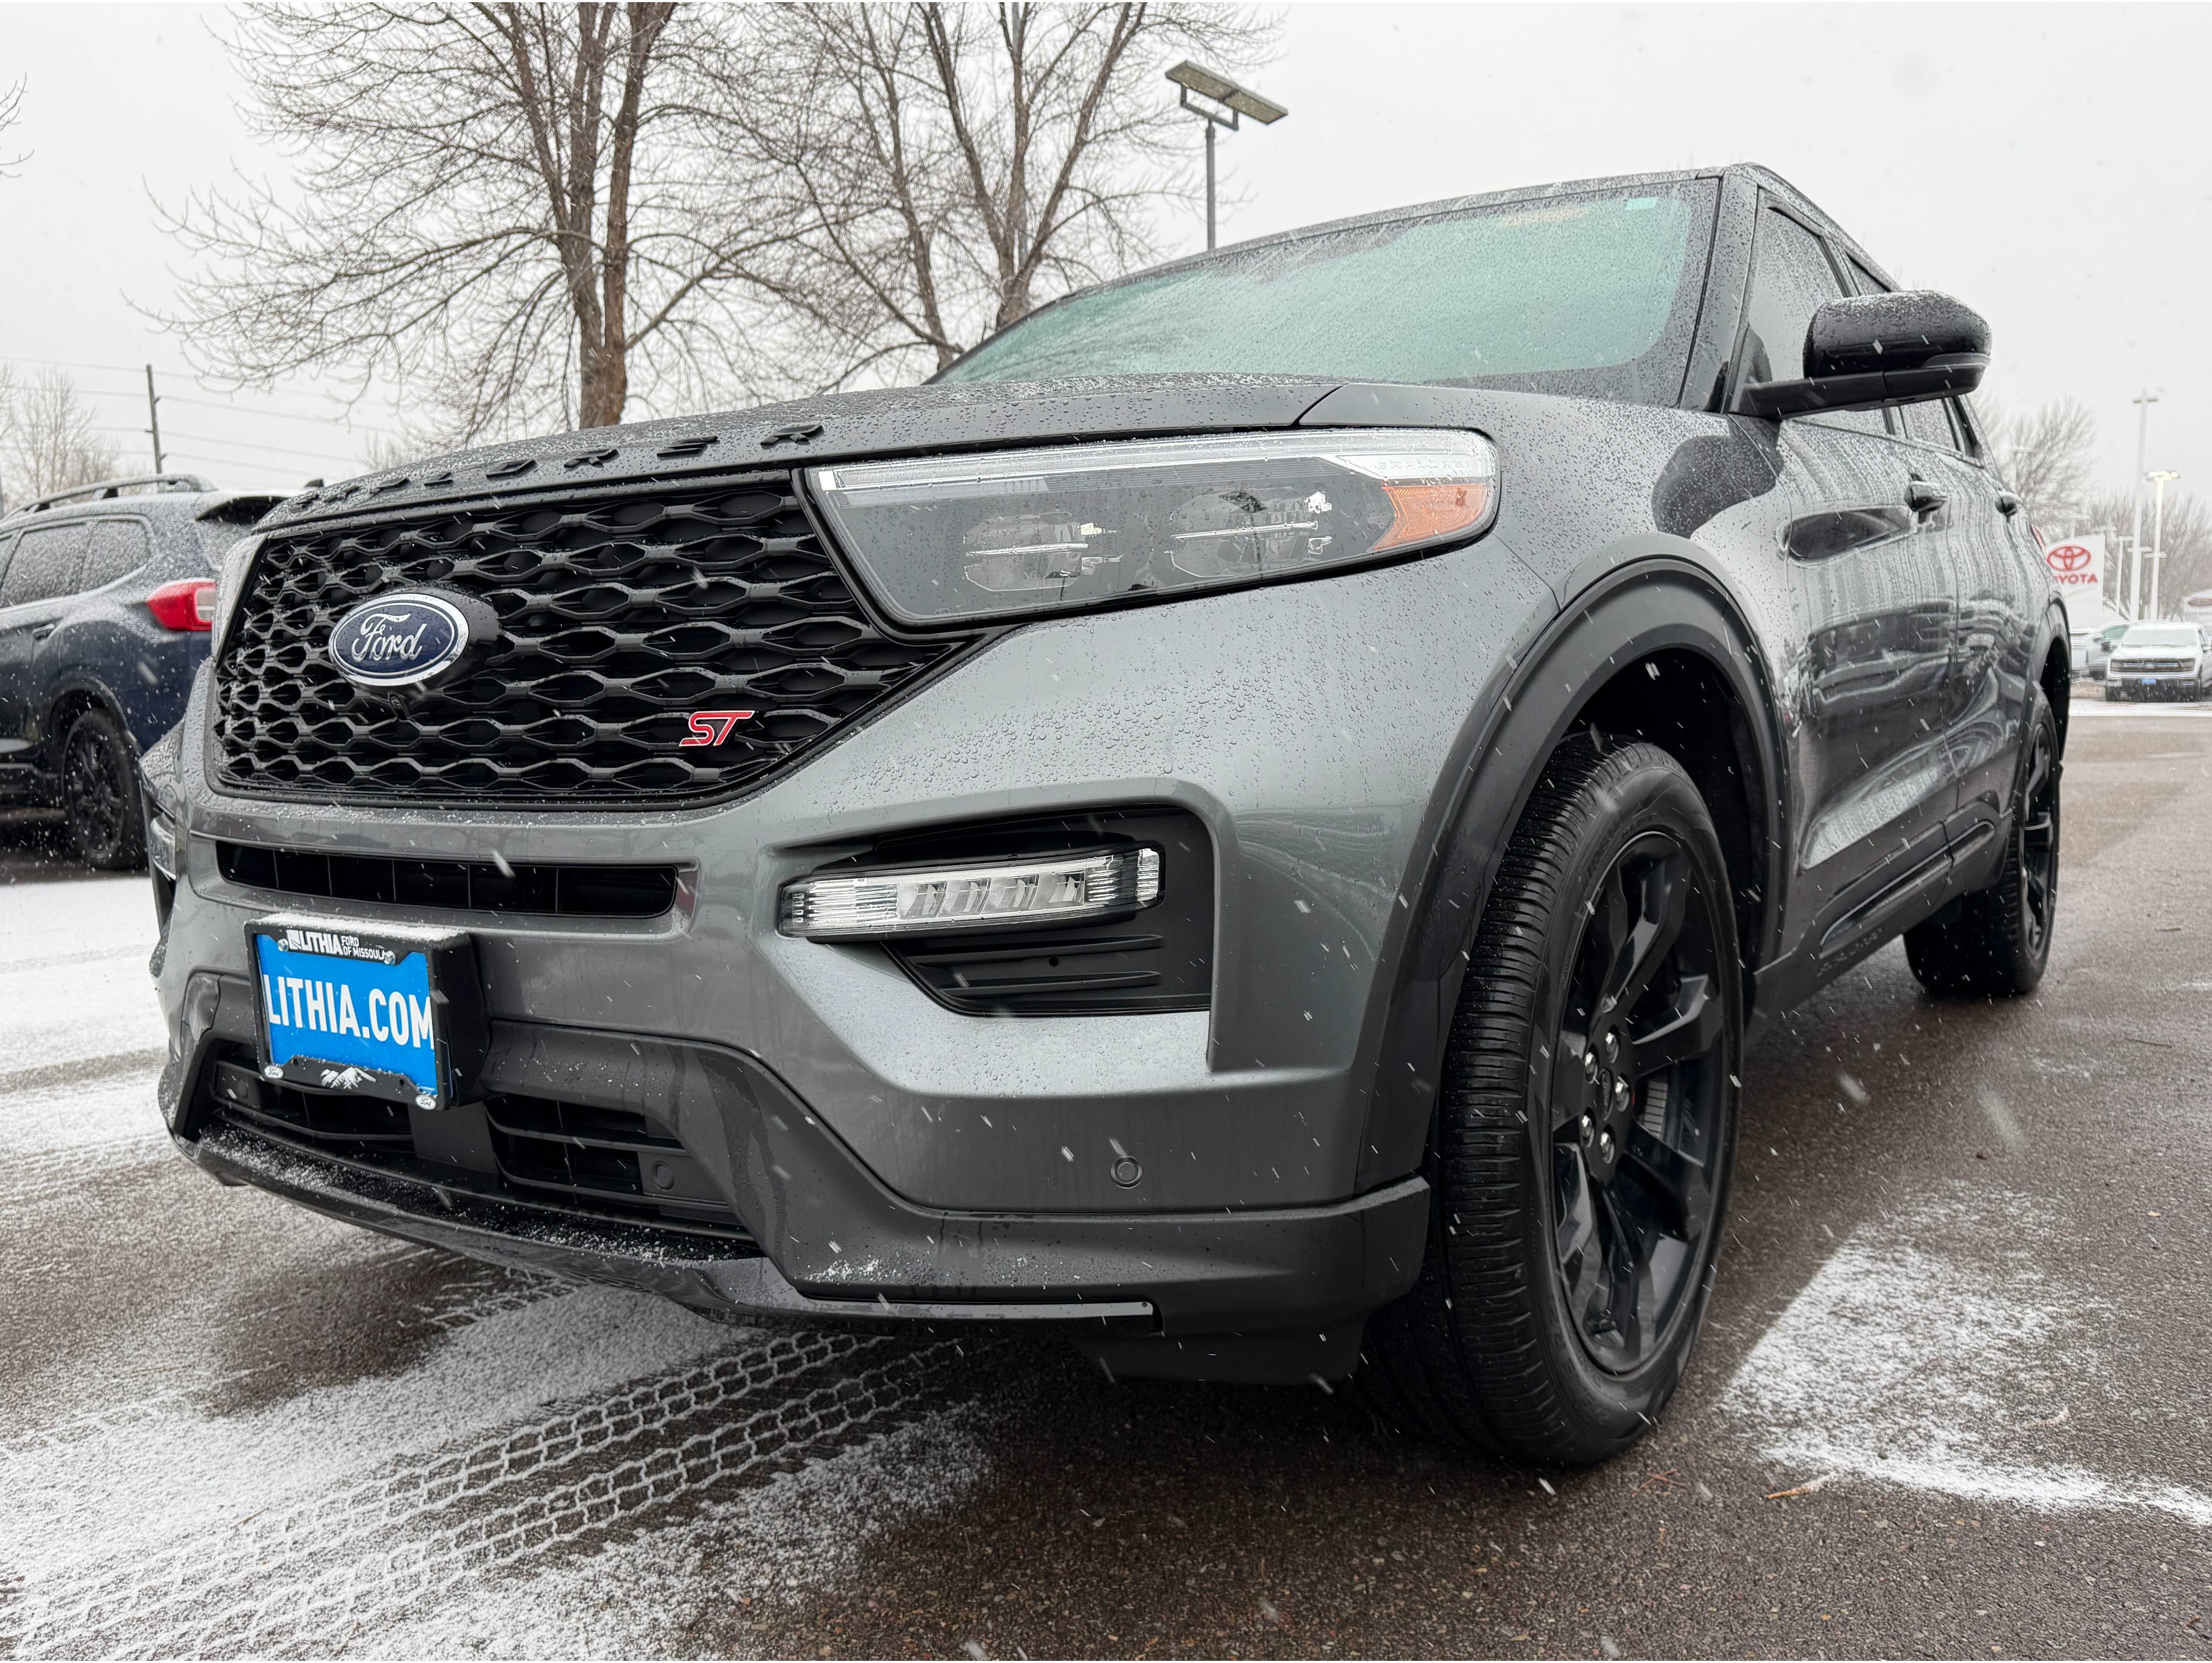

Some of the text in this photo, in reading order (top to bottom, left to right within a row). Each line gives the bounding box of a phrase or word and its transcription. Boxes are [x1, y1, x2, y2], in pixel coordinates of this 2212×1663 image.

[2054, 574, 2098, 585] YOTA
[351, 613, 428, 662] Ford
[678, 710, 755, 747] ST
[299, 930, 344, 955] LITHIA
[341, 935, 360, 947] FORD
[343, 947, 352, 956] OF
[263, 974, 434, 1050] LITHIA.COM
[420, 1097, 432, 1106] Ford
